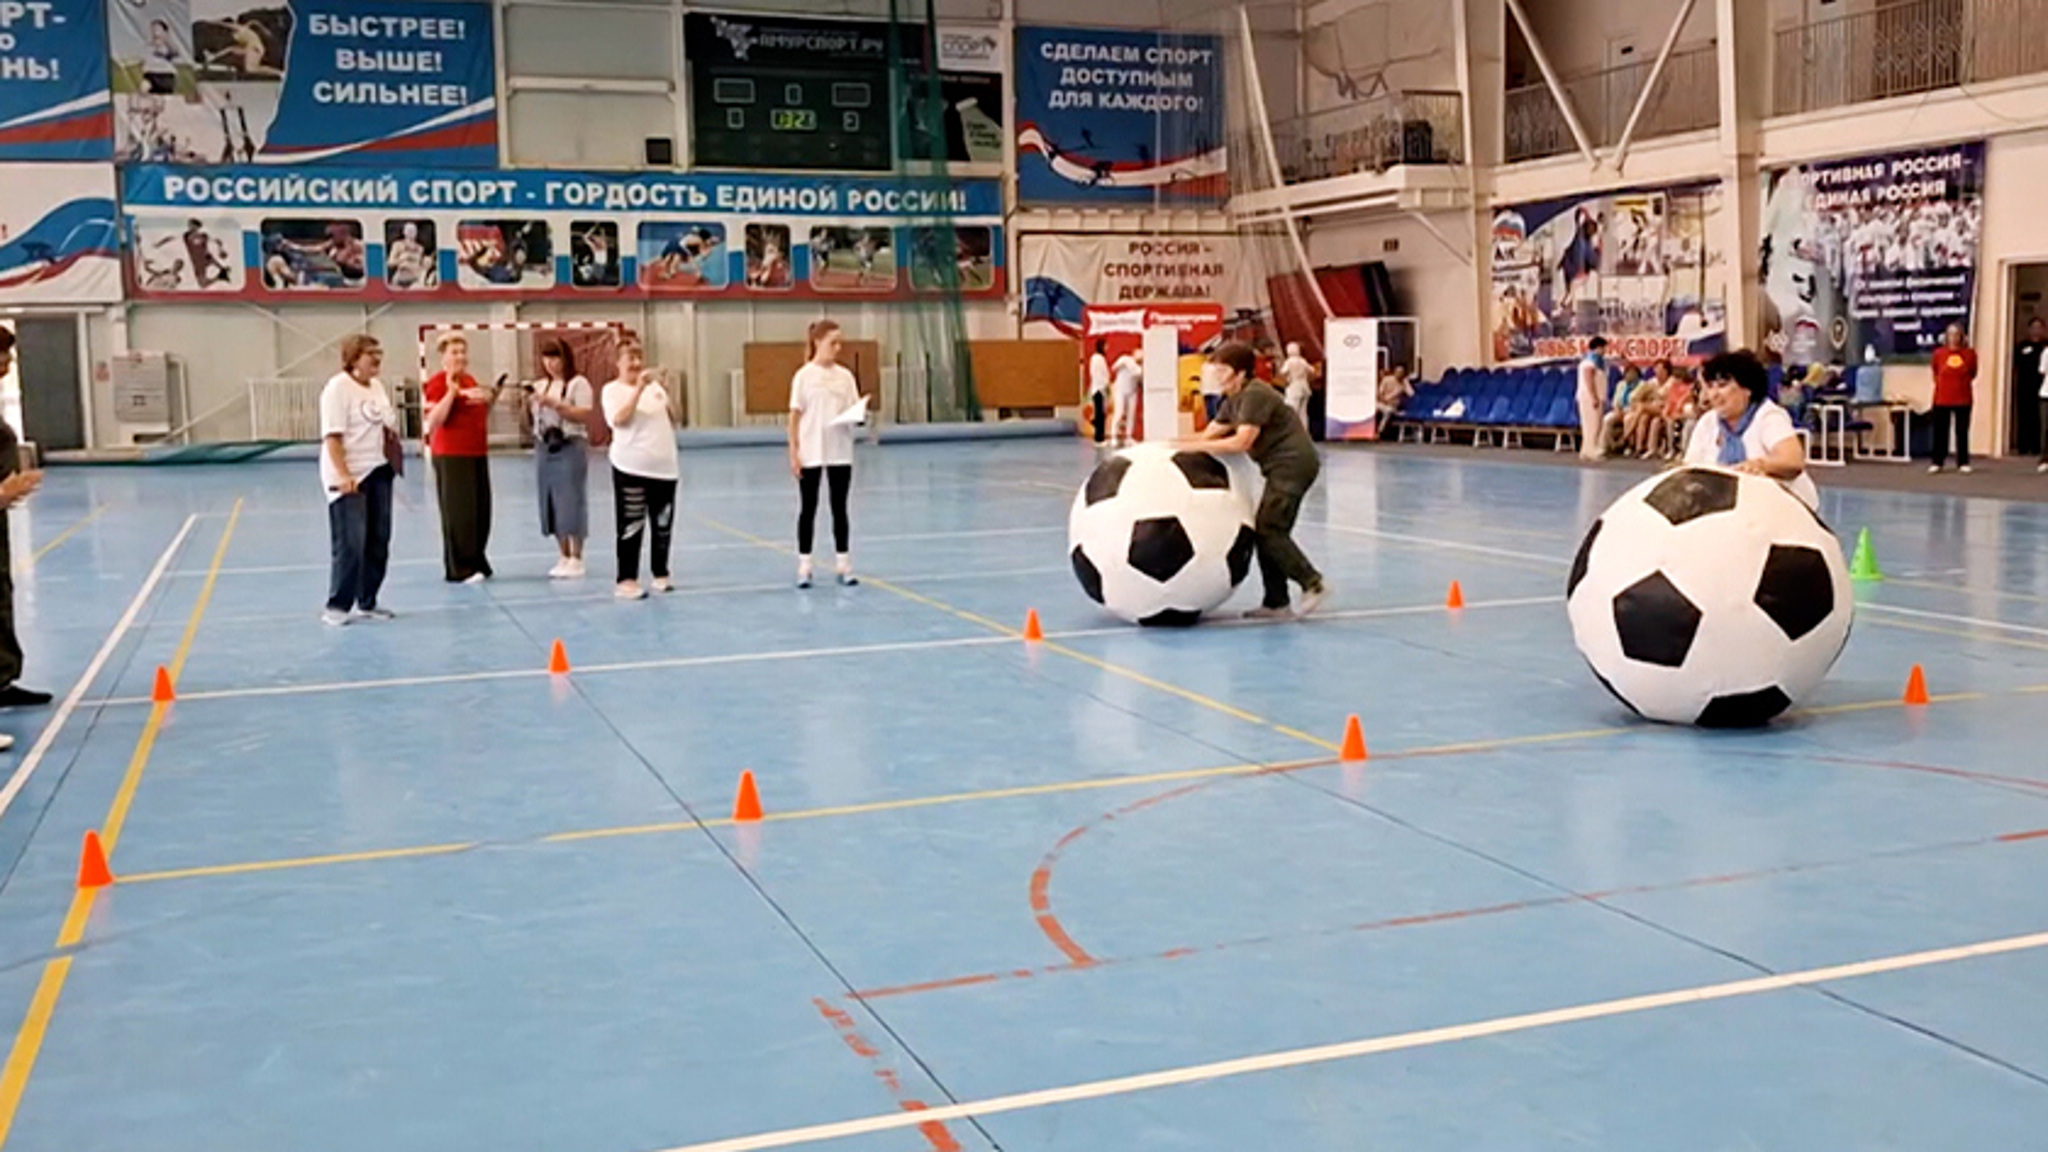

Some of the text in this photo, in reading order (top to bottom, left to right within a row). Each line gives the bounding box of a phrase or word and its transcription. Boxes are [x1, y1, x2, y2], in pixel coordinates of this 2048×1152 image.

[1, 2, 66, 28] РТ-
[309, 14, 466, 39] БЫСТРЕЕ!
[336, 48, 442, 72] ВЫШЕ!
[1041, 42, 1212, 65] СДЕЛАЕМ СПОРТ
[1, 56, 60, 80] НЬ!
[1060, 67, 1193, 87] ДОСТУПНЫМ
[313, 80, 467, 106] СИЛЬНЕЕ!
[1048, 90, 1204, 112] ДЛЯ КАЖДОГО!
[1792, 163, 1885, 186] ОРТИВНАЯ
[163, 173, 398, 203] РОССИЙСКИЙ
[409, 180, 516, 205] СПОРТ
[545, 182, 707, 209] ГОРДОСТЬ
[716, 184, 838, 212] ЕДИНОЙ
[847, 189, 966, 213] РОССИИ!
[1878, 180, 1946, 201] РОССИЯ
[1129, 241, 1200, 256] РОССИЯ
[1104, 263, 1224, 278] СПОРТИВНАЯ
[1119, 284, 1211, 300] ДЕРЖАВА!
